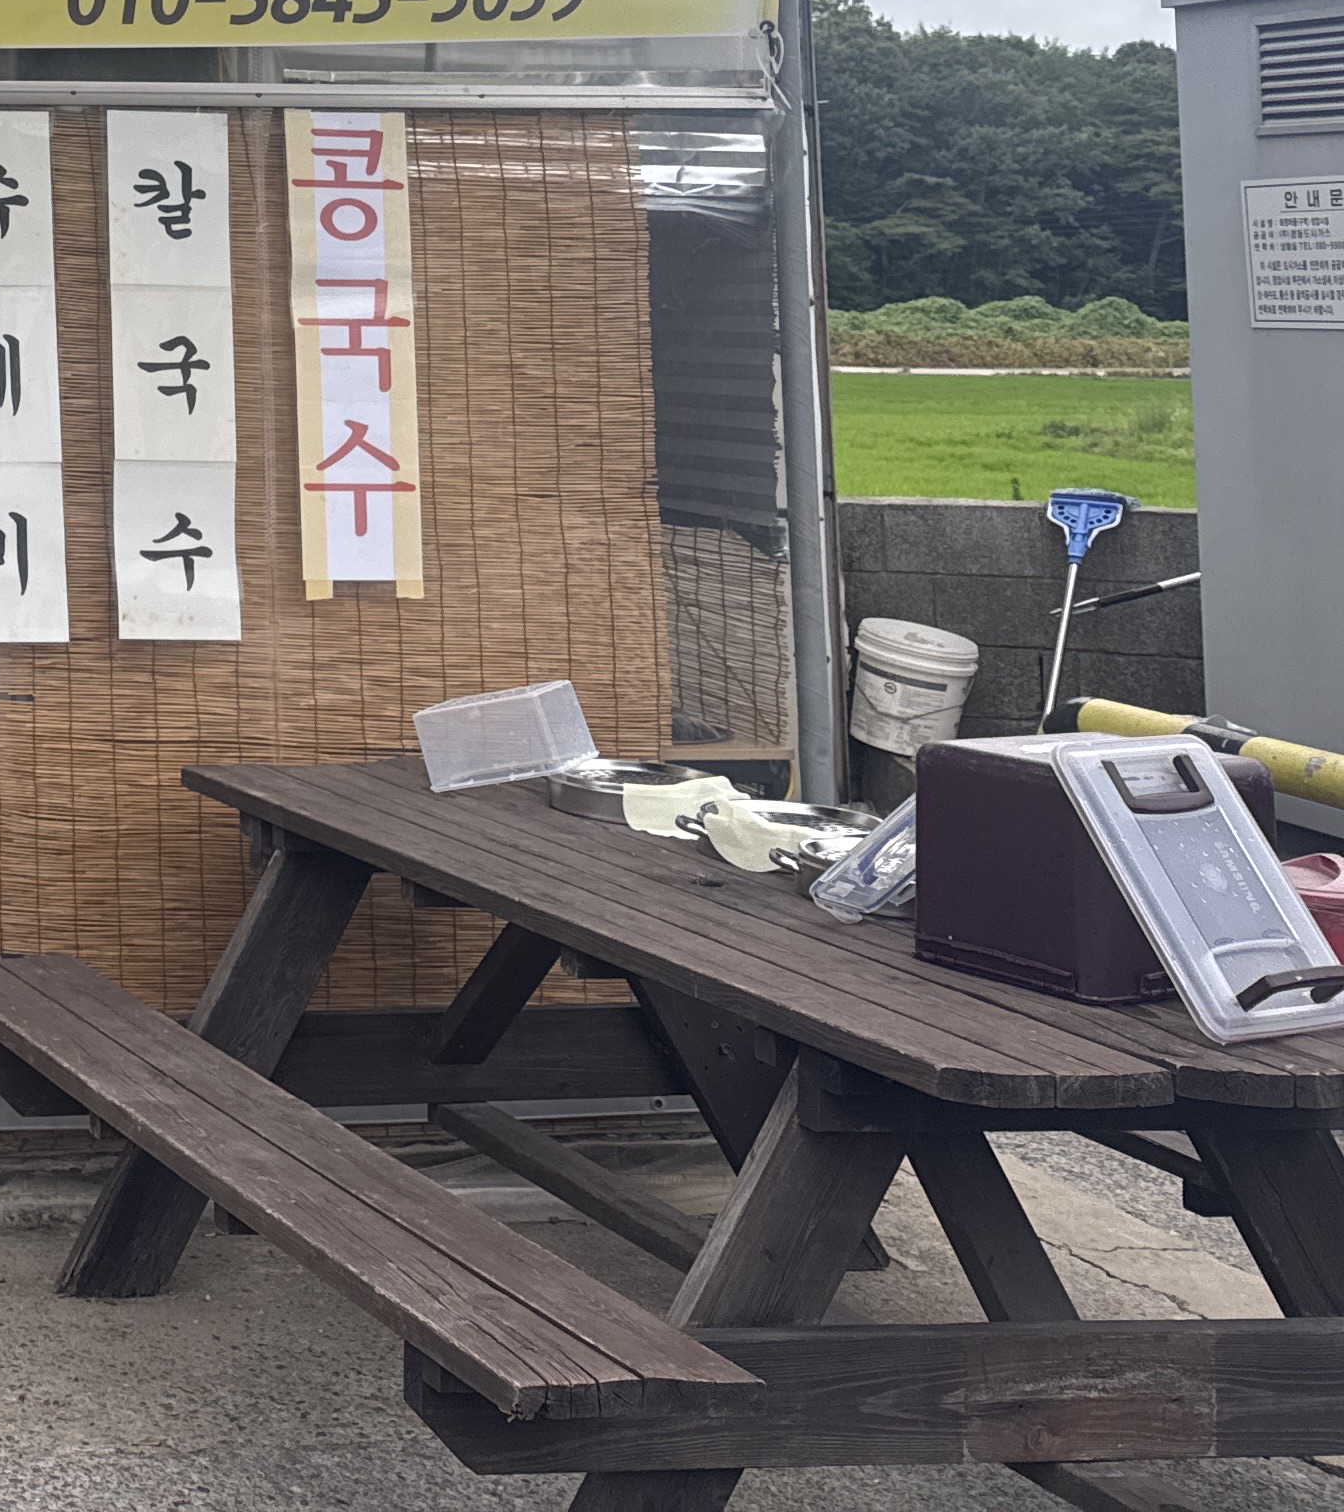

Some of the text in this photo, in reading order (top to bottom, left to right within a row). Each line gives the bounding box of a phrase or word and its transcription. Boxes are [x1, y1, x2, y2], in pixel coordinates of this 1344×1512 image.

[132, 160, 213, 592] 칼국수
[291, 127, 417, 537] 콩국수
[1213, 839, 1262, 915] SAMSUNG
